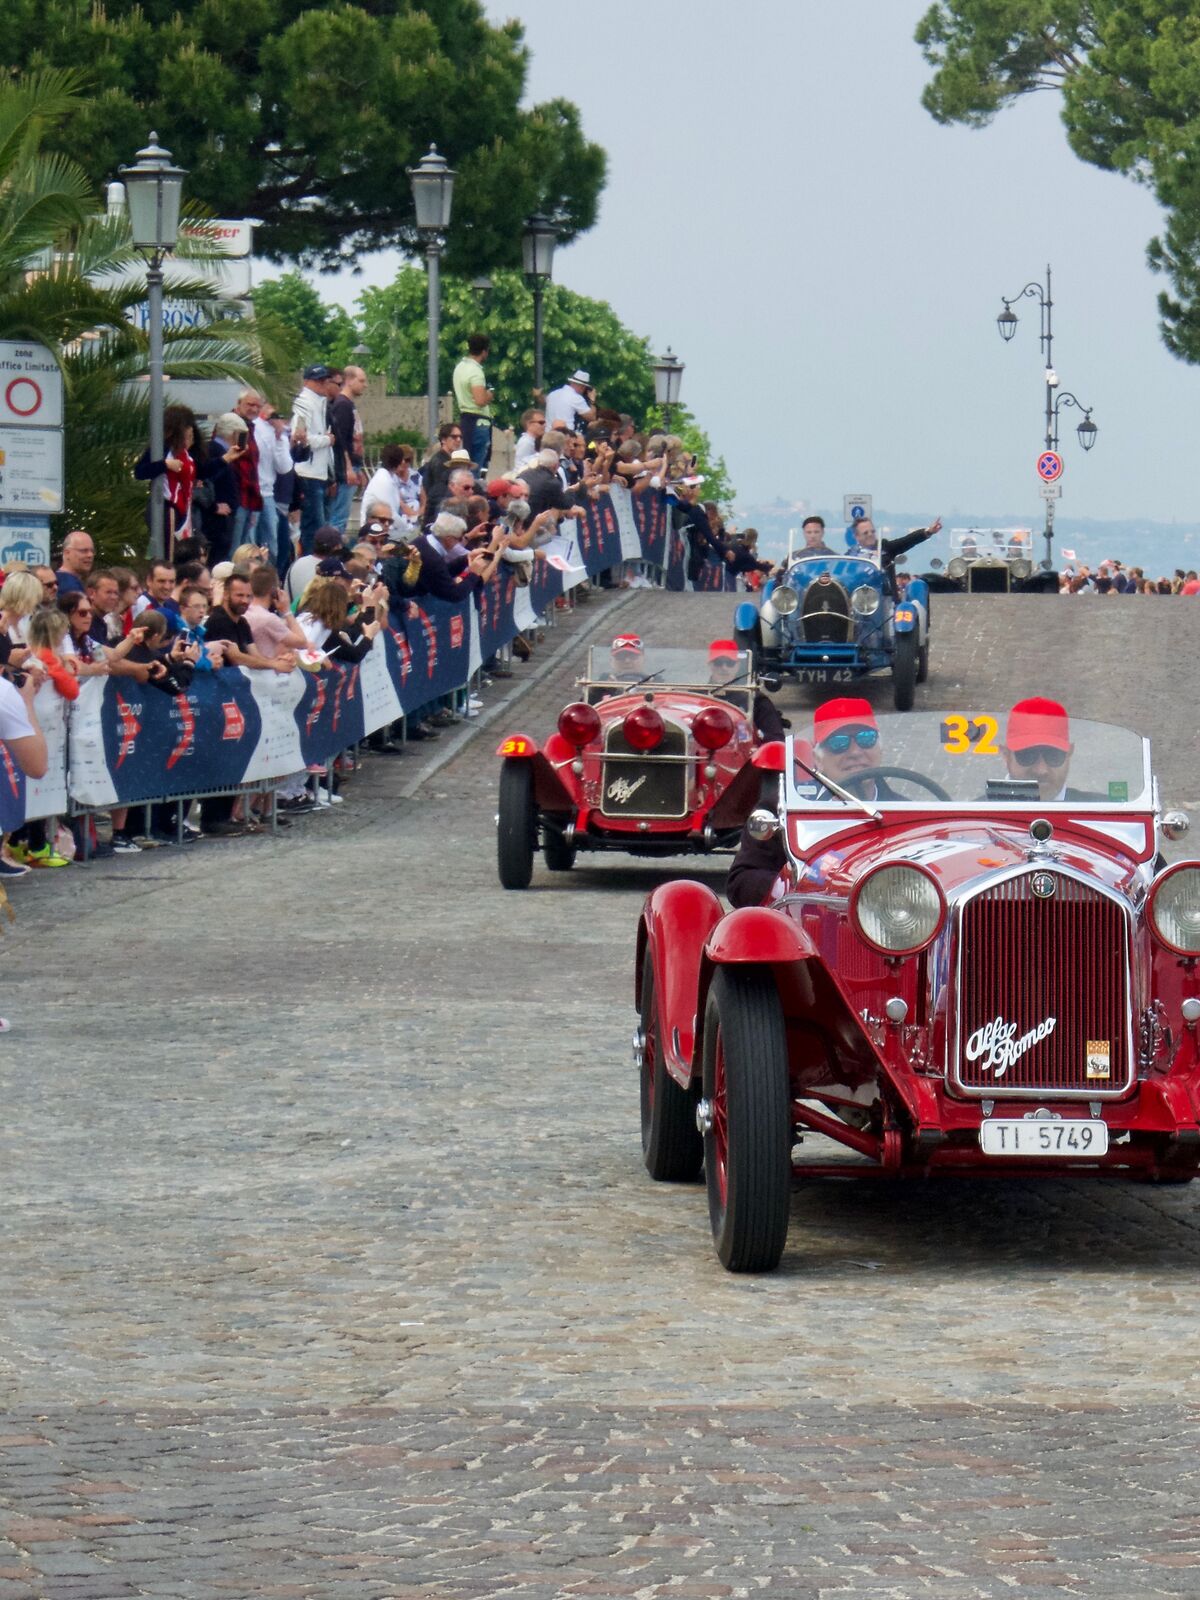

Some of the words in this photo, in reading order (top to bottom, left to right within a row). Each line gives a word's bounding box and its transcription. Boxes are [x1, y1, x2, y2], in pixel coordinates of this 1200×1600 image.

[796, 670, 827, 682] TYH
[832, 670, 853, 682] 42
[502, 741, 526, 753] 31
[944, 714, 999, 754] 32
[966, 1016, 1018, 1071] Alfa
[989, 1017, 1057, 1078] Romeo
[996, 1126, 1020, 1149] TI
[1039, 1127, 1093, 1150] 5749
